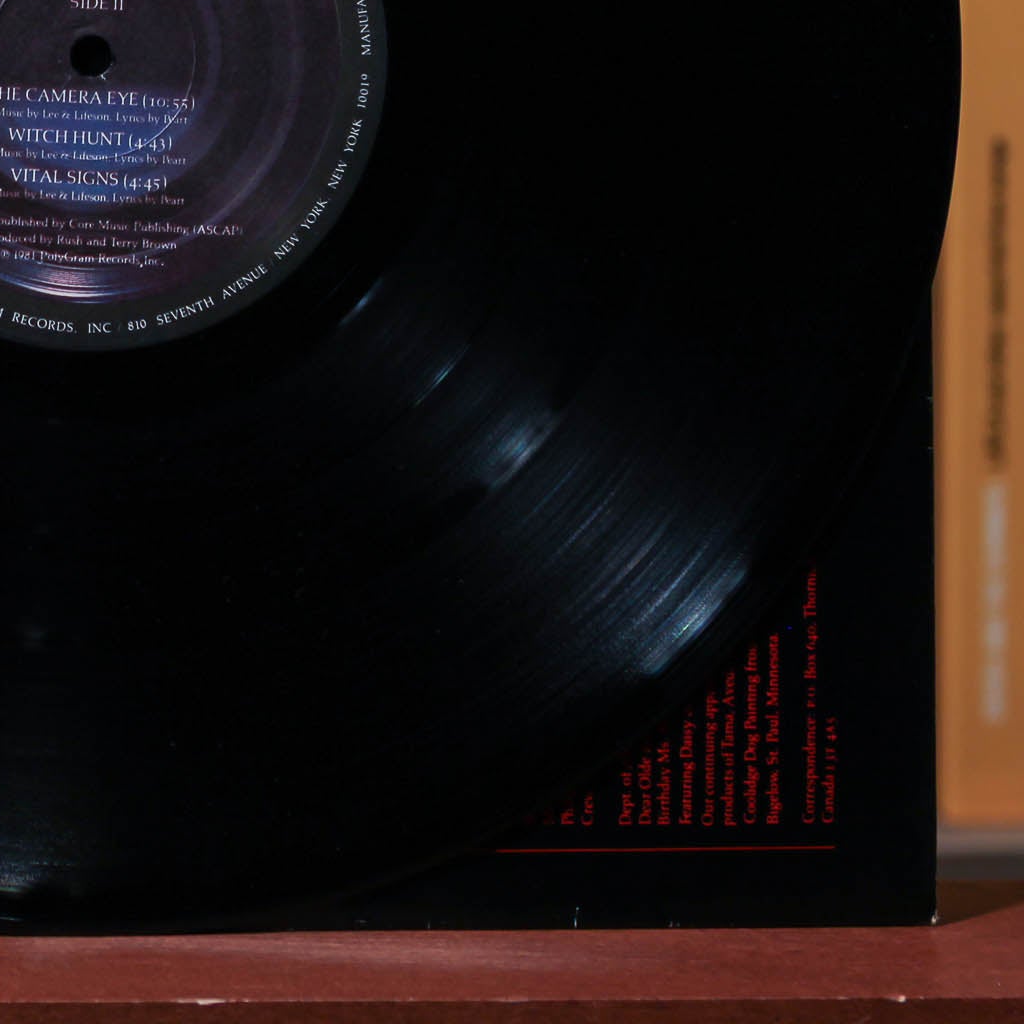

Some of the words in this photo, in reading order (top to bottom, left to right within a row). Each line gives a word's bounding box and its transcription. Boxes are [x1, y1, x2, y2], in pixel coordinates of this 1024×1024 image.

[26, 88, 102, 105] CAMERA
[107, 92, 138, 106] EYE
[142, 95, 195, 111] (10:55)
[27, 107, 40, 119] by
[42, 108, 61, 119] Lee
[116, 111, 145, 124] Lyrics
[148, 112, 160, 124] by
[163, 113, 188, 125] Peart
[8, 127, 68, 144] WITCH
[73, 130, 125, 146] HUNT
[128, 135, 172, 152] (4:43)
[26, 147, 38, 160] by
[41, 148, 59, 159] Lee
[114, 151, 144, 164] Lyrics
[146, 153, 157, 165] by
[162, 154, 187, 165] Peart
[10, 167, 63, 183] VITAL
[67, 170, 119, 186] SIGNS
[123, 175, 167, 191] (4:45)
[39, 189, 57, 199] Lee
[113, 193, 142, 205] Lyrics
[160, 195, 185, 206] Peart
[87, 322, 112, 334] INC
[127, 318, 147, 332] 810
[155, 295, 215, 326] SEVENTH
[222, 263, 268, 300] AVENUE
[273, 232, 300, 260] NEW
[327, 159, 348, 190] NEW
[343, 119, 363, 153] YORK
[356, 73, 370, 109] 10019
[52, 216, 65, 230] by
[69, 217, 93, 229] Core
[98, 219, 128, 231] Music
[133, 220, 191, 235] Publishing
[40, 233, 53, 246] by
[57, 234, 83, 246] Rush
[85, 236, 107, 247] and
[111, 238, 139, 249] Terry
[142, 239, 177, 249] Brown
[14, 250, 36, 261] 1981
[40, 251, 95, 264] PolyGram
